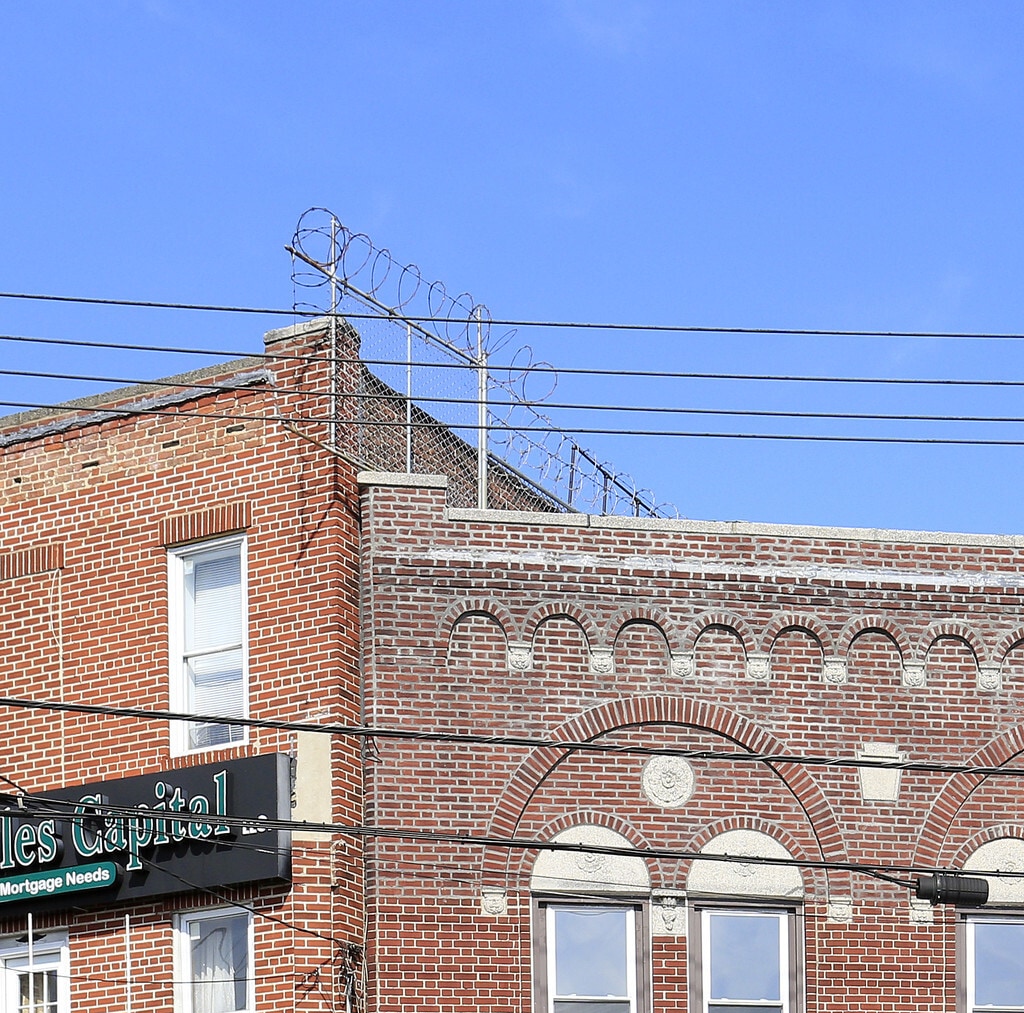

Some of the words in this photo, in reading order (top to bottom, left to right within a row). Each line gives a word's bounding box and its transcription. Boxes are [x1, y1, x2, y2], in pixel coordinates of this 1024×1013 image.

[71, 769, 230, 872] Capital
[0, 877, 63, 896] Mortgage
[65, 867, 110, 886] Needs
